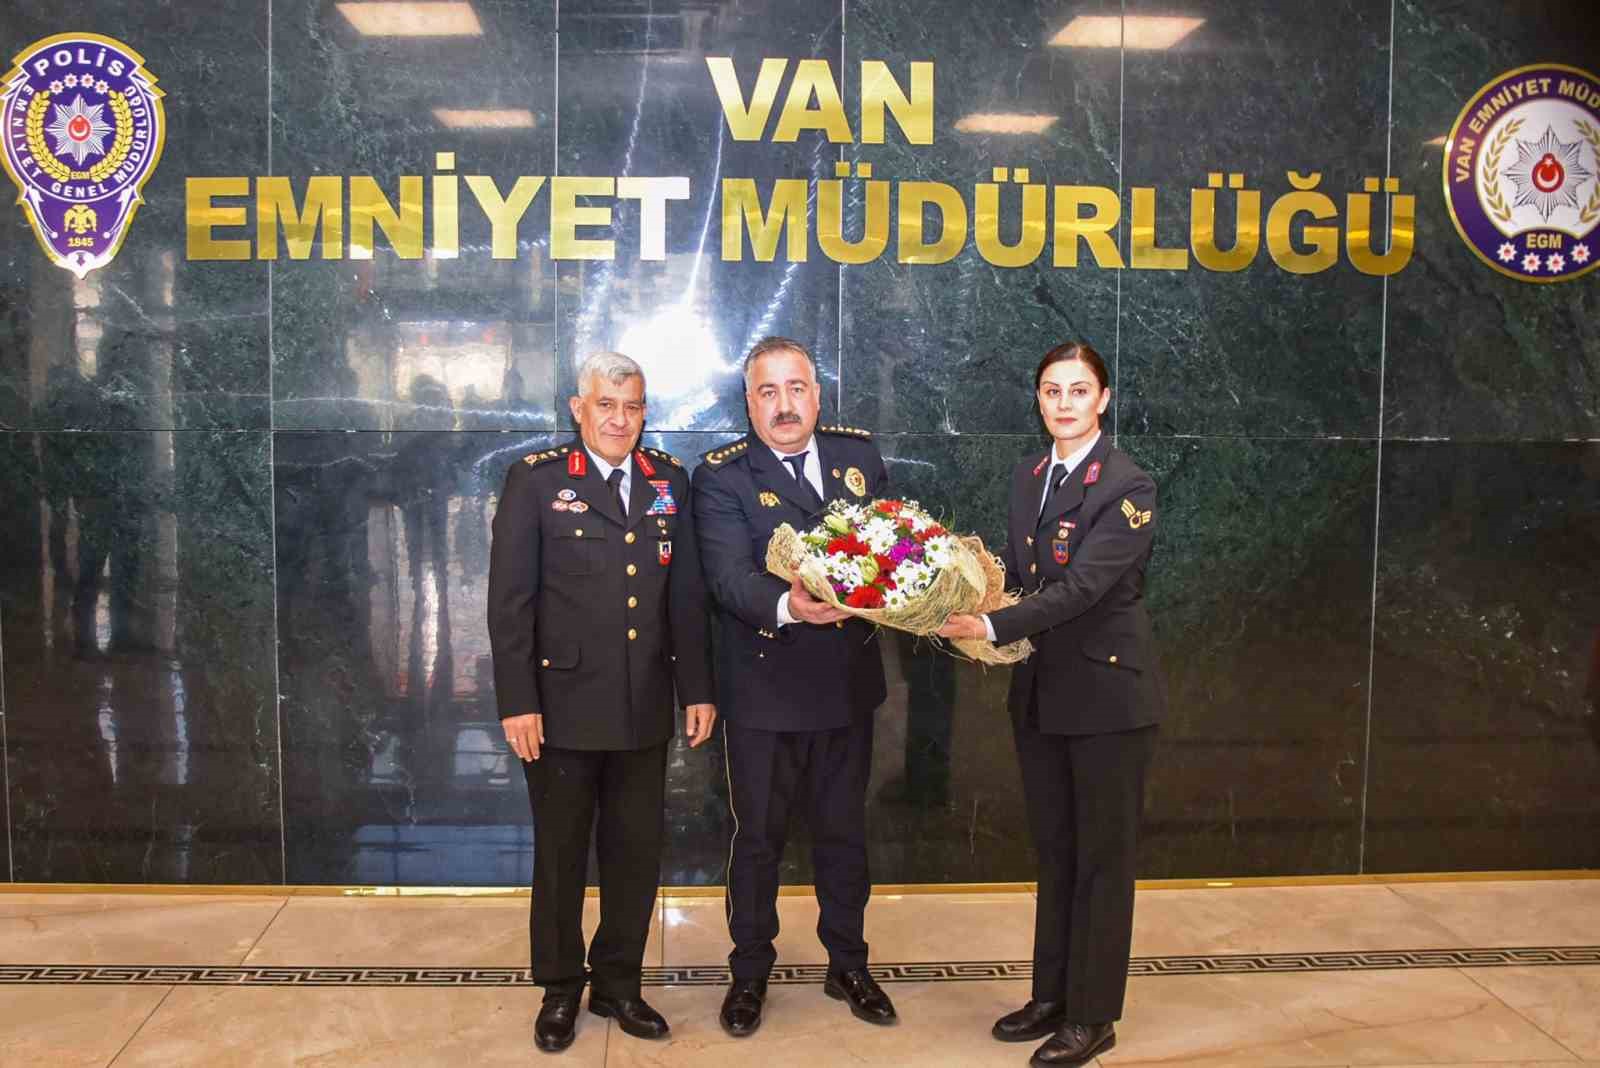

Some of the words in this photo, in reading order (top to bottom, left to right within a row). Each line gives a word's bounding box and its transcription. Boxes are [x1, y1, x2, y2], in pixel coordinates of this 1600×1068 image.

[34, 48, 125, 76] POLİS
[707, 56, 934, 145] VAN
[1456, 137, 1475, 183] VAN
[1468, 78, 1552, 134] EMNİYET
[51, 182, 109, 198] GENEL
[185, 151, 690, 261] EMNİYET
[721, 160, 1415, 276] MÜDÜRLÜĞÜ
[67, 237, 94, 247] 1845
[1526, 233, 1562, 249] EGM
